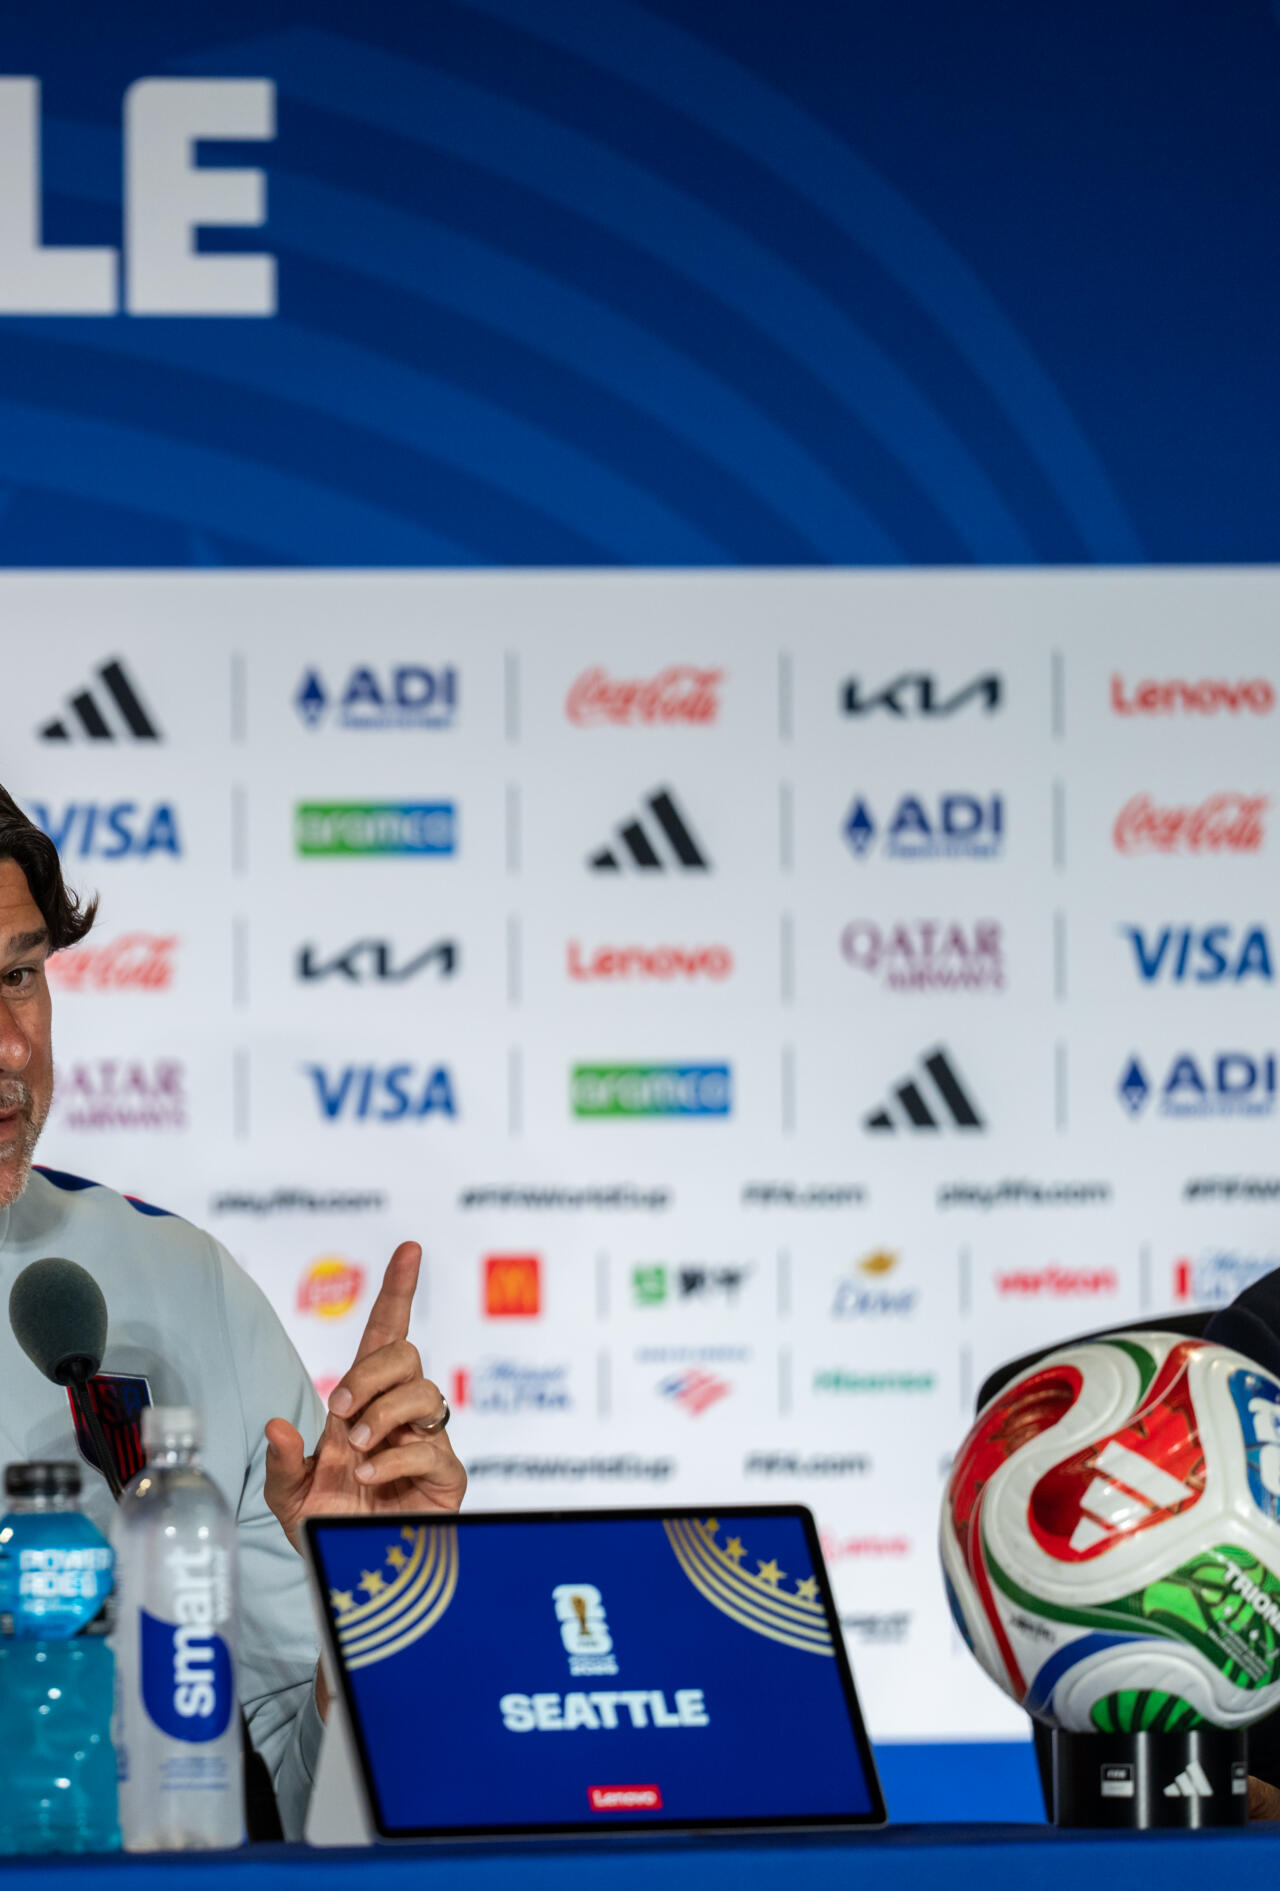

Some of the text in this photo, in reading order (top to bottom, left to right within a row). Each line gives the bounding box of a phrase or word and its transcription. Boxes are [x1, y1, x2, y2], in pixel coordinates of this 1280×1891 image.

[339, 664, 458, 704] ADI
[840, 673, 1003, 717] KIA
[1110, 674, 1276, 715] Lenovo
[34, 803, 181, 858] VISA
[887, 794, 1005, 841] ADI
[296, 939, 459, 983] KIA
[567, 941, 734, 981] Lenovo
[841, 920, 1003, 971] QATAR
[1120, 924, 1275, 984] VISA
[60, 1059, 184, 1097] ATAR
[302, 1063, 459, 1123] VISA
[1162, 1053, 1277, 1096] ADI
[165, 1545, 217, 1718] smart
[499, 1689, 710, 1733] SEATTLE
[592, 1789, 658, 1809] Lenovo
